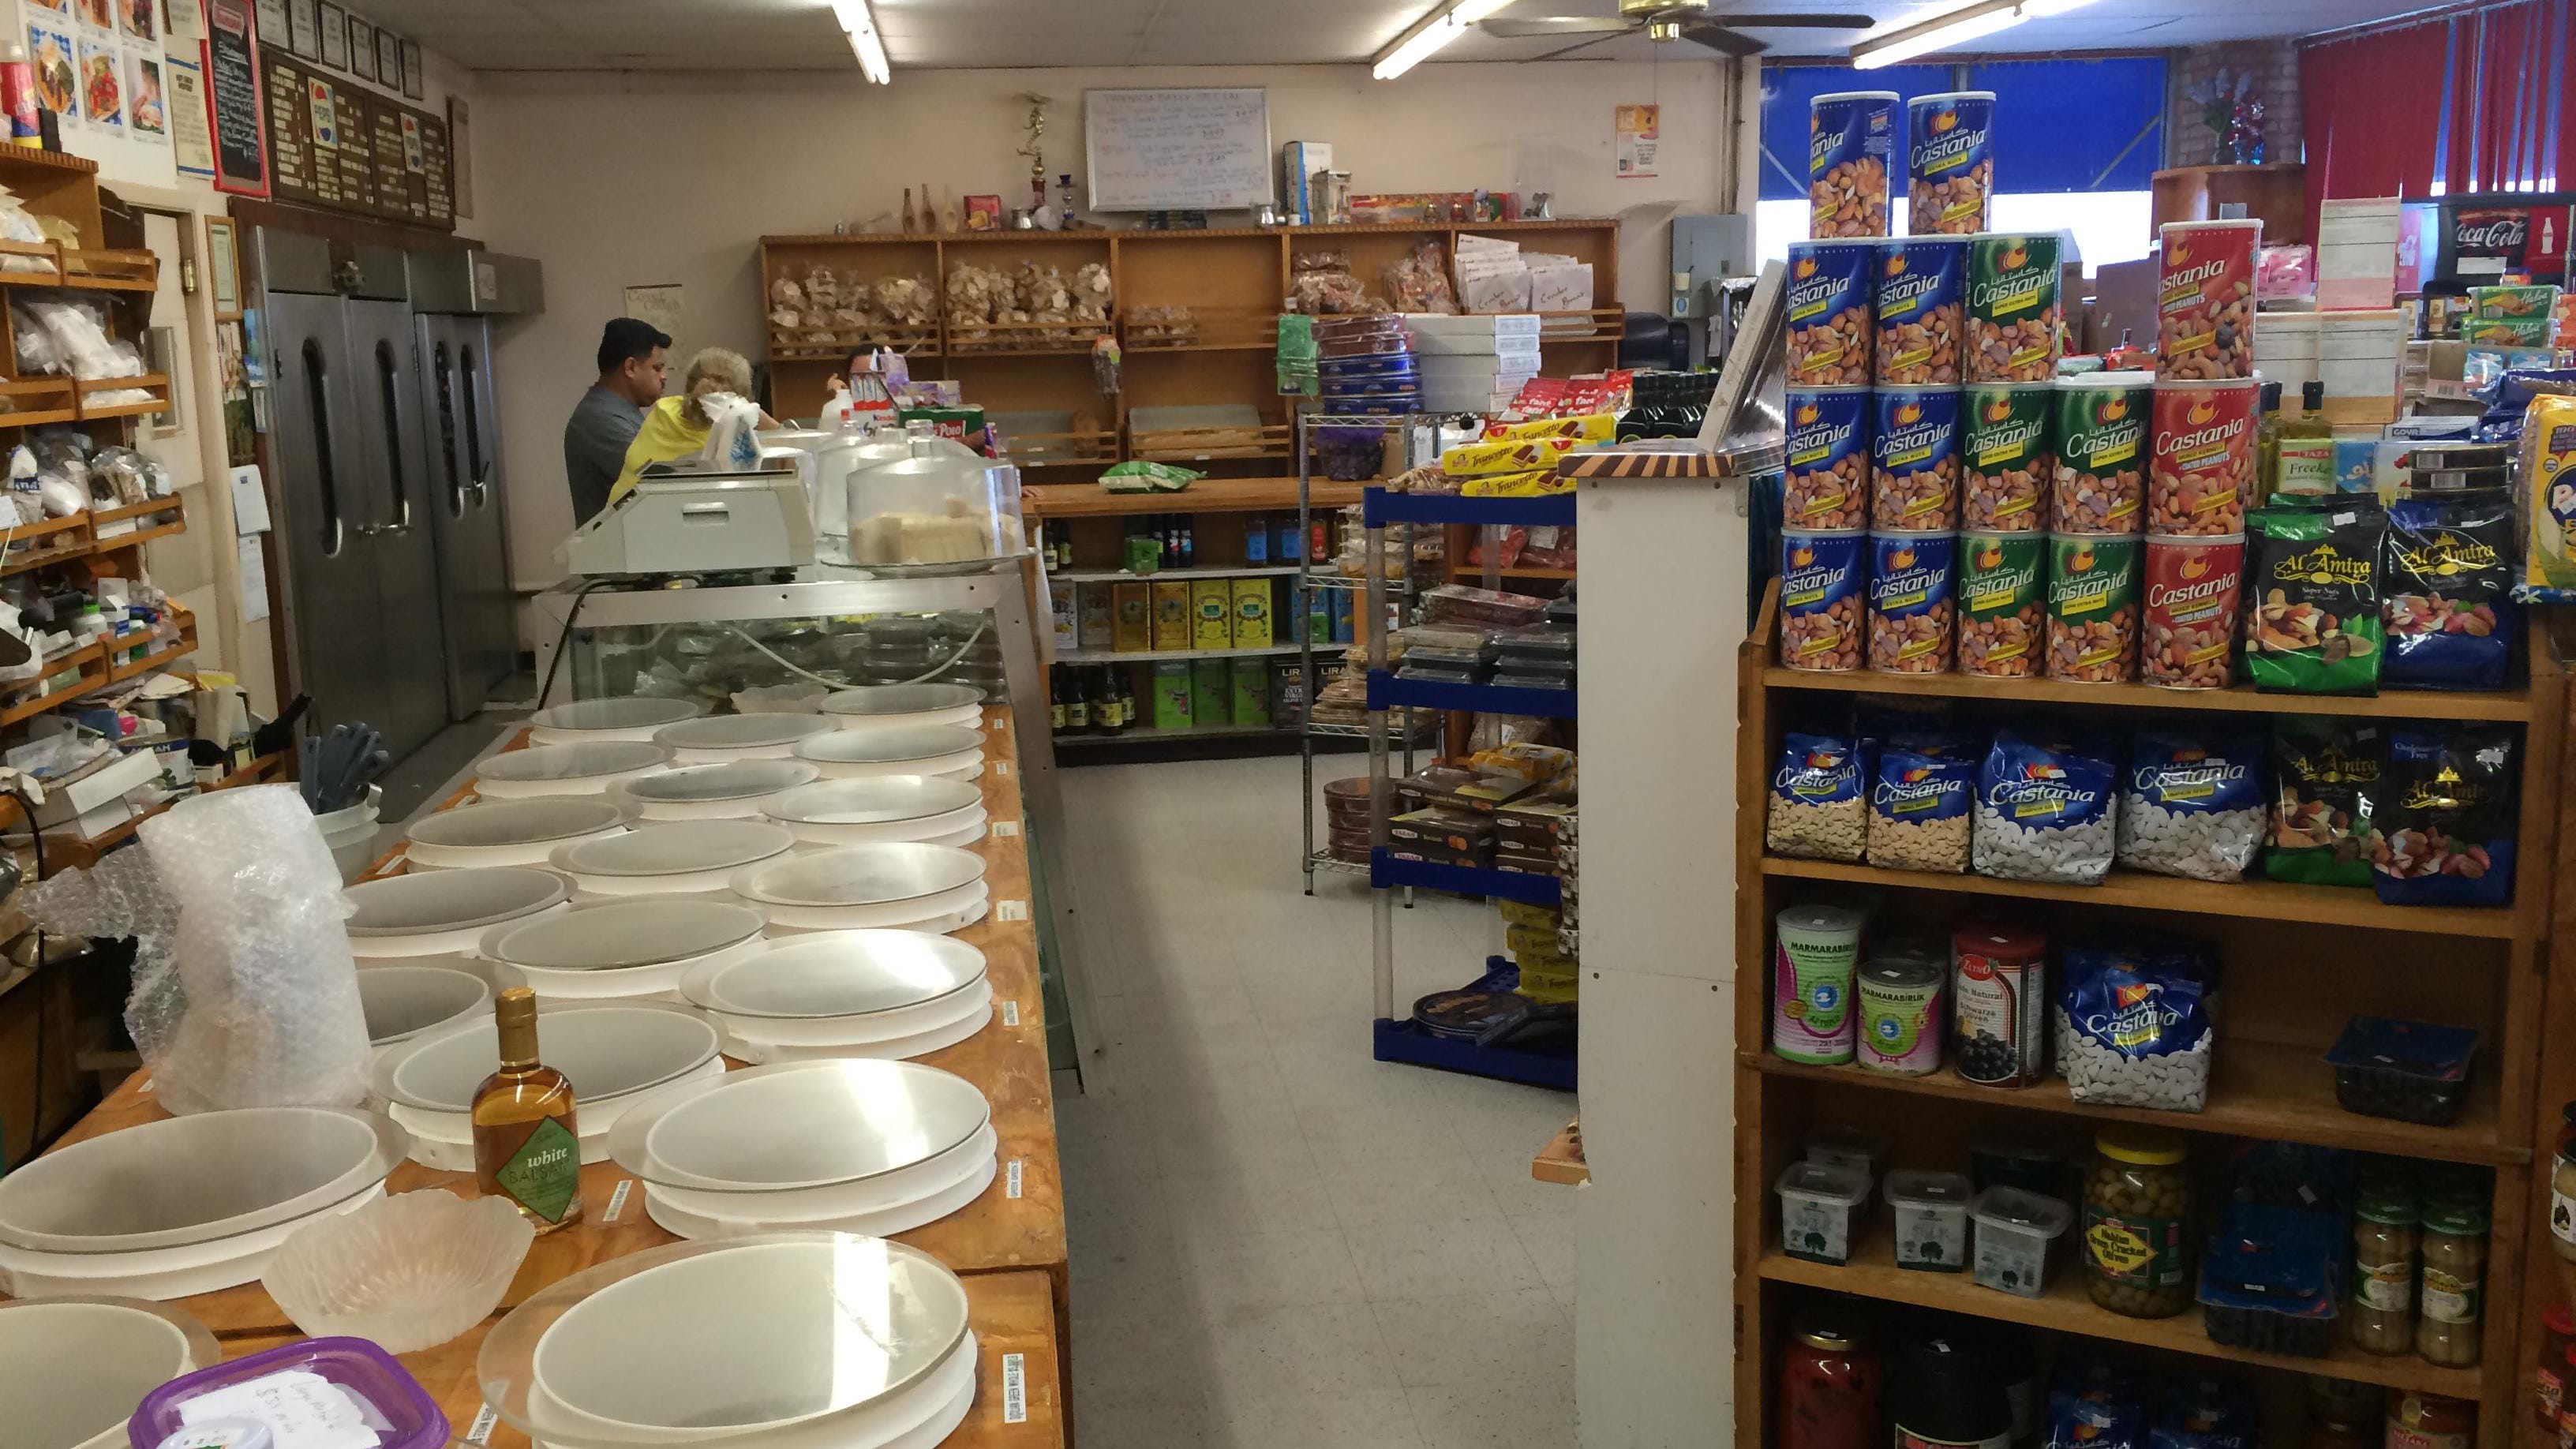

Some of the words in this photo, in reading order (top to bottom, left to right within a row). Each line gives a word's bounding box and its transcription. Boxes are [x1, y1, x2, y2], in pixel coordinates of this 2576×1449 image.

[1911, 129, 1986, 169] Castania
[2456, 219, 2525, 249] Coca-Cola
[1787, 276, 1850, 310] astania
[1878, 275, 1939, 309] astania
[1974, 268, 2055, 308] Castania
[1875, 424, 1951, 458] Castania
[1964, 419, 2043, 457] Castania
[2156, 417, 2245, 456] Castania
[1472, 446, 1513, 467] Trancetto
[2200, 452, 2231, 467] PEANUTS
[1496, 472, 1537, 493] Trancetto
[2275, 554, 2305, 573] Al
[2308, 554, 2372, 579] Amira
[2401, 546, 2429, 568] Al
[2435, 542, 2496, 568] Amira
[1870, 568, 1945, 600] Castania
[1959, 568, 2035, 601] Castania
[2048, 571, 2128, 605] Castania
[2149, 572, 2236, 608] Castania
[2193, 606, 2223, 622] PEANUTS
[1282, 668, 1301, 676] LIR
[1776, 764, 1856, 788] Castania
[2134, 762, 2247, 792] Castania
[1874, 778, 1962, 805] Castania
[1990, 781, 2095, 806] Castania
[1971, 988, 2003, 1000] Natural
[2087, 1010, 2180, 1034] Castania
[527, 1148, 568, 1168] white
